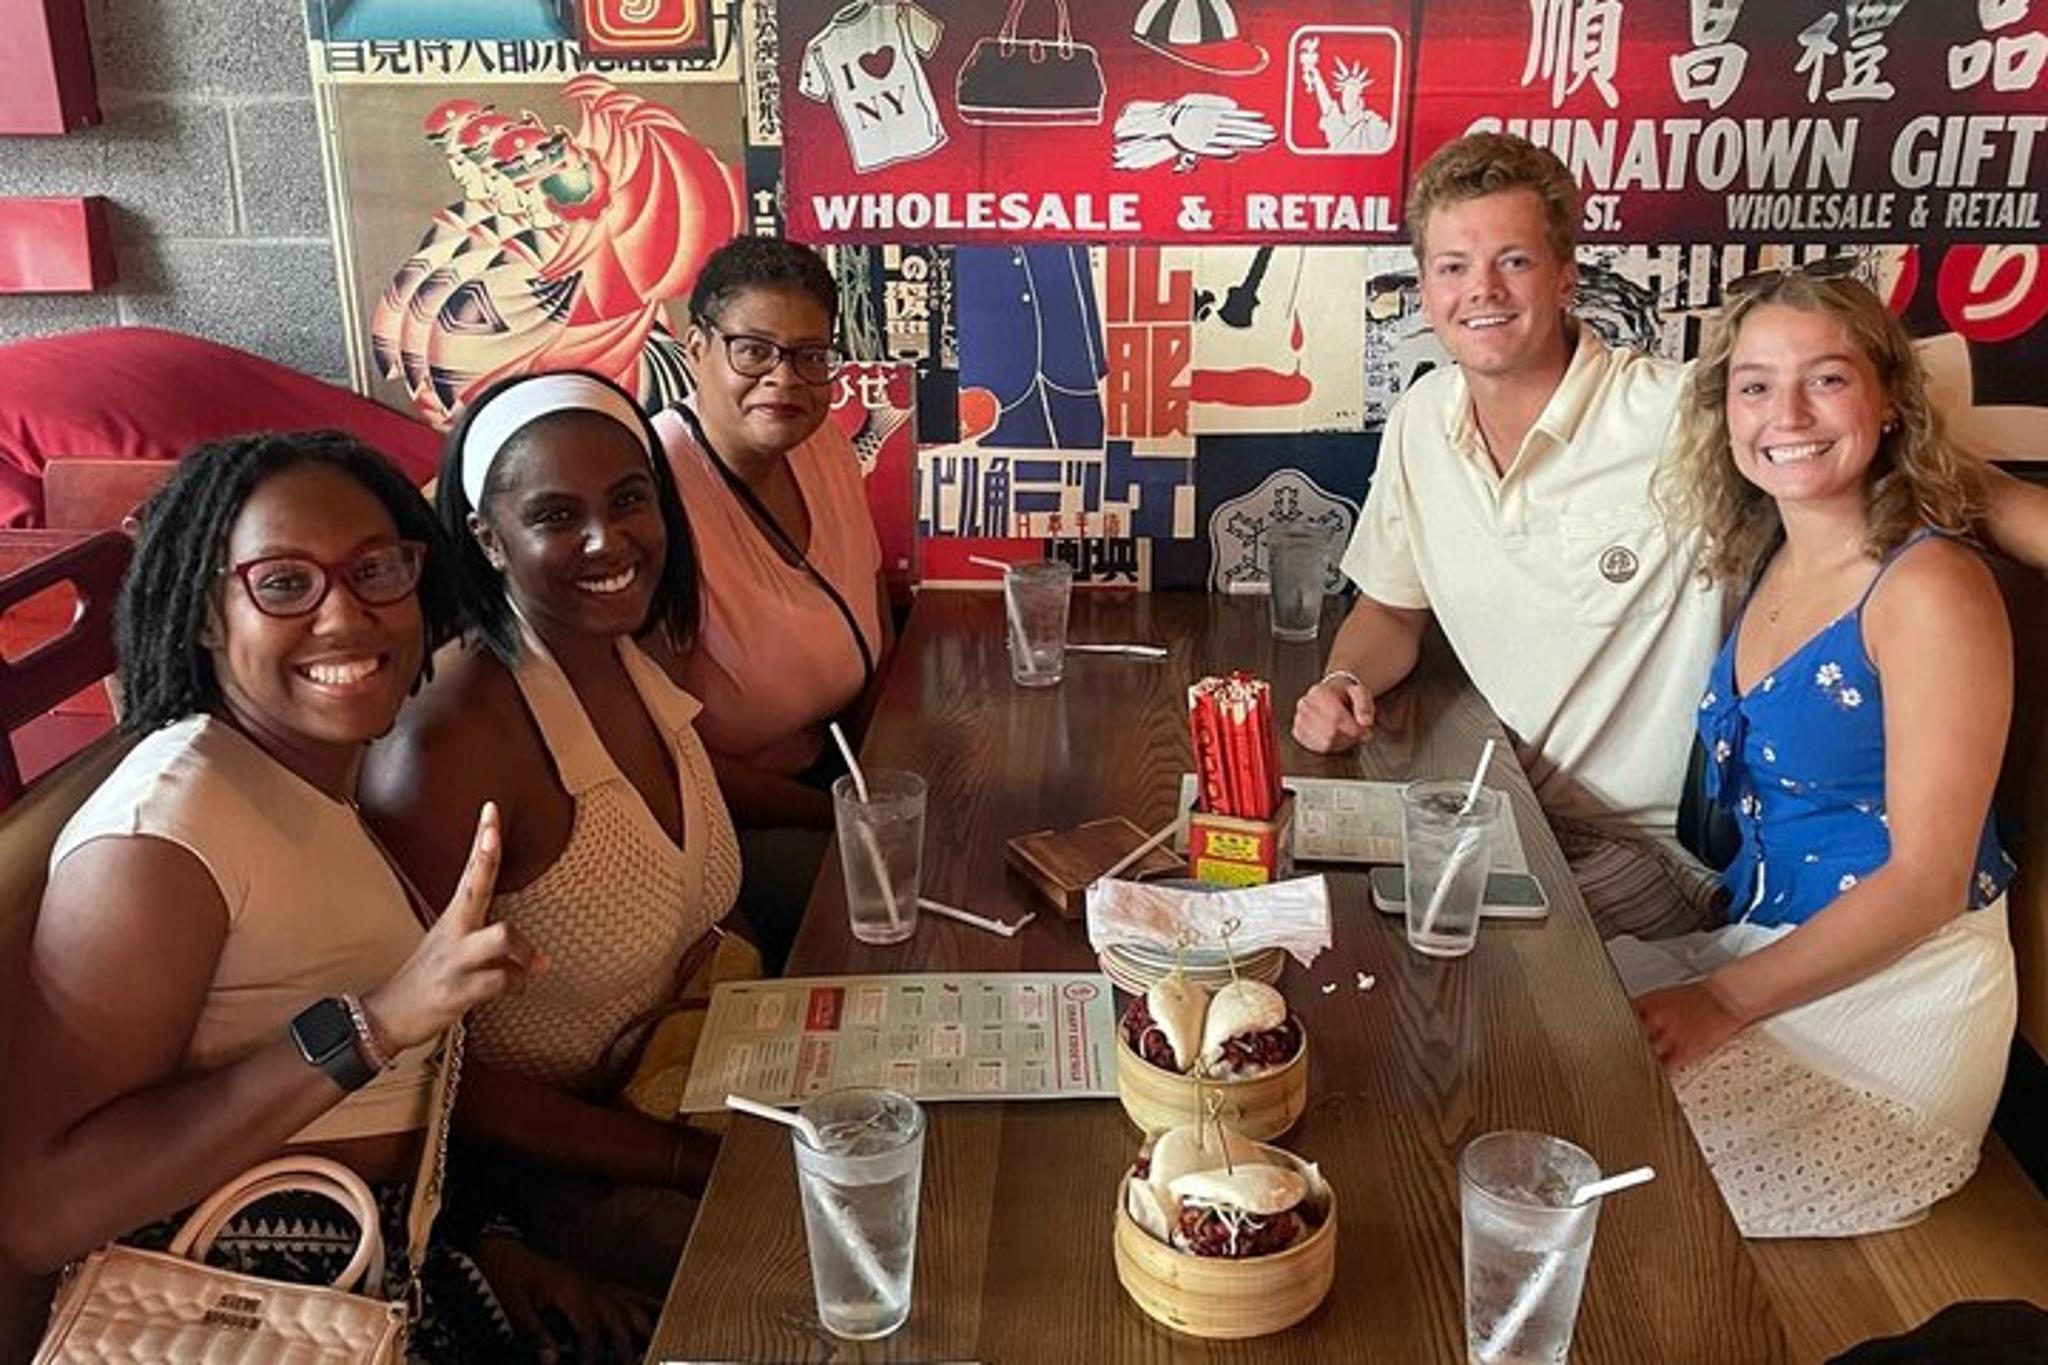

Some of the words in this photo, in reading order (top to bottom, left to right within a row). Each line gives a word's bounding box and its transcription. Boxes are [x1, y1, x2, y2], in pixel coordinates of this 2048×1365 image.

[841, 62, 856, 91] I
[854, 84, 906, 130] NY
[1463, 117, 1858, 192] INATOWN
[1891, 115, 2047, 189] GIFT
[812, 193, 1142, 232] WHOLESALE
[1177, 195, 1213, 231] &
[1247, 194, 1398, 232] RETAIL
[1583, 194, 1623, 232] ST.
[1726, 194, 1895, 230] WHOLESALE
[1909, 195, 1930, 229] &
[1945, 193, 2041, 228] RETAIL
